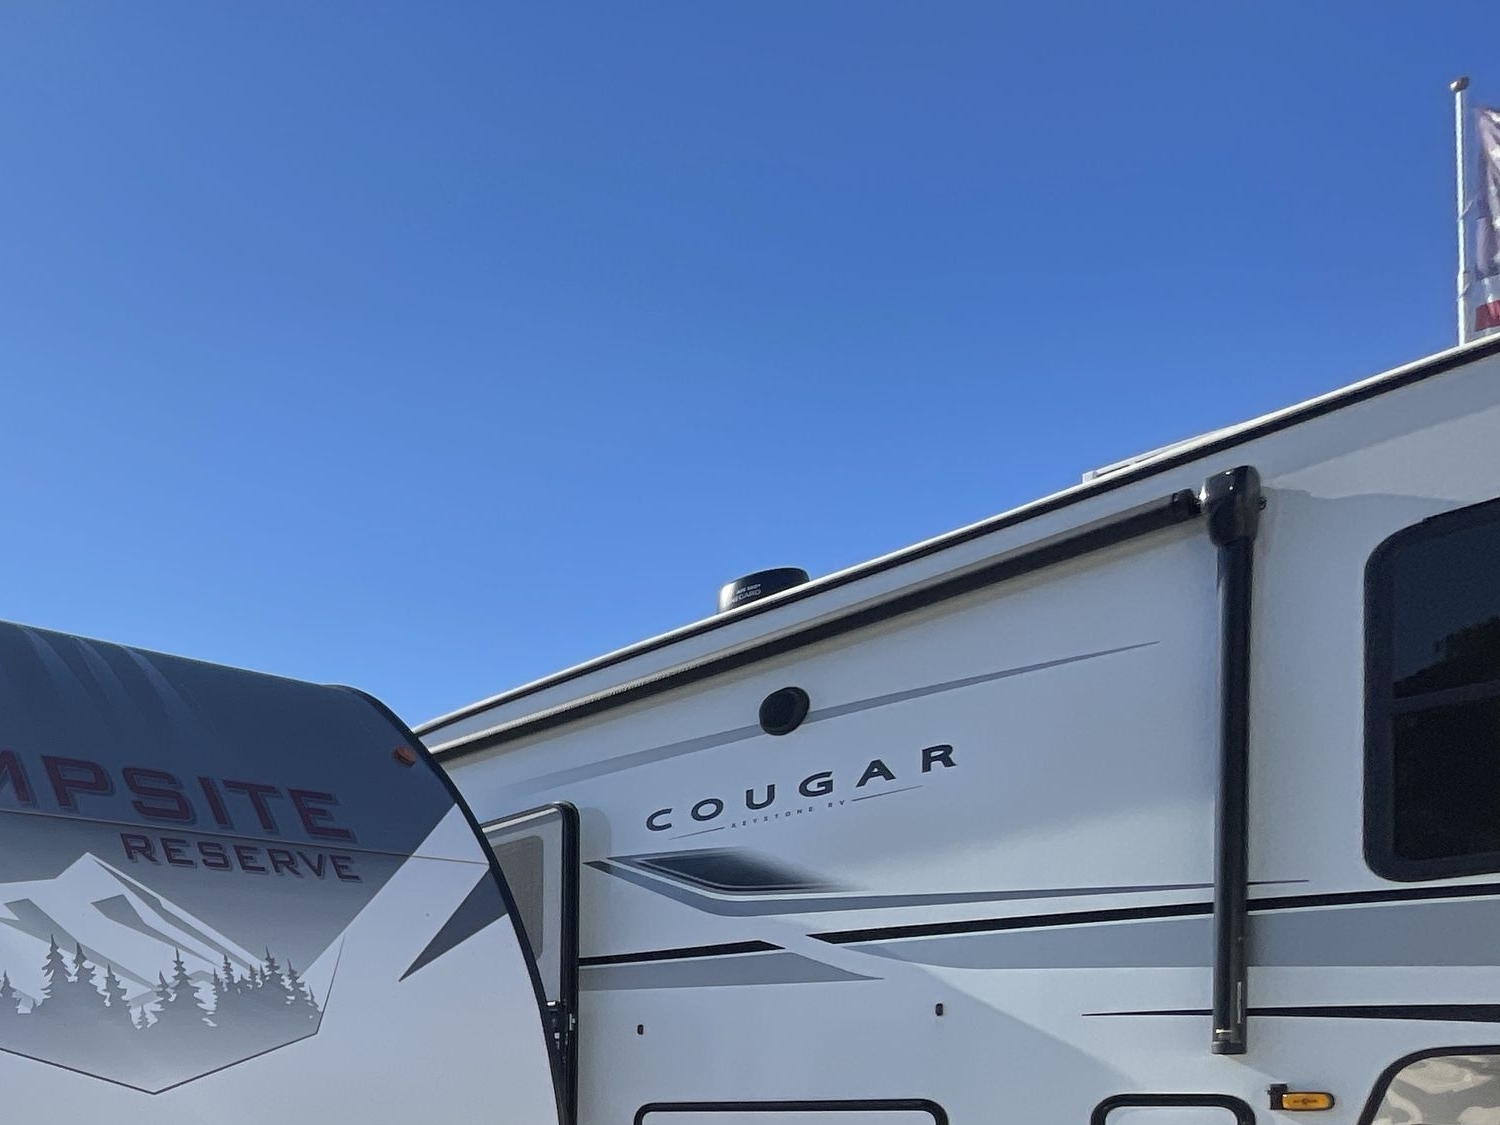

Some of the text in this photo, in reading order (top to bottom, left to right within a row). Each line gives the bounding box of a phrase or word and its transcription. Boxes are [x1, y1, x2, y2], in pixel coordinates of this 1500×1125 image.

[646, 744, 957, 832] COUGAR
[731, 800, 845, 828] KEYSTONE RV
[120, 832, 362, 884] RESERVE
